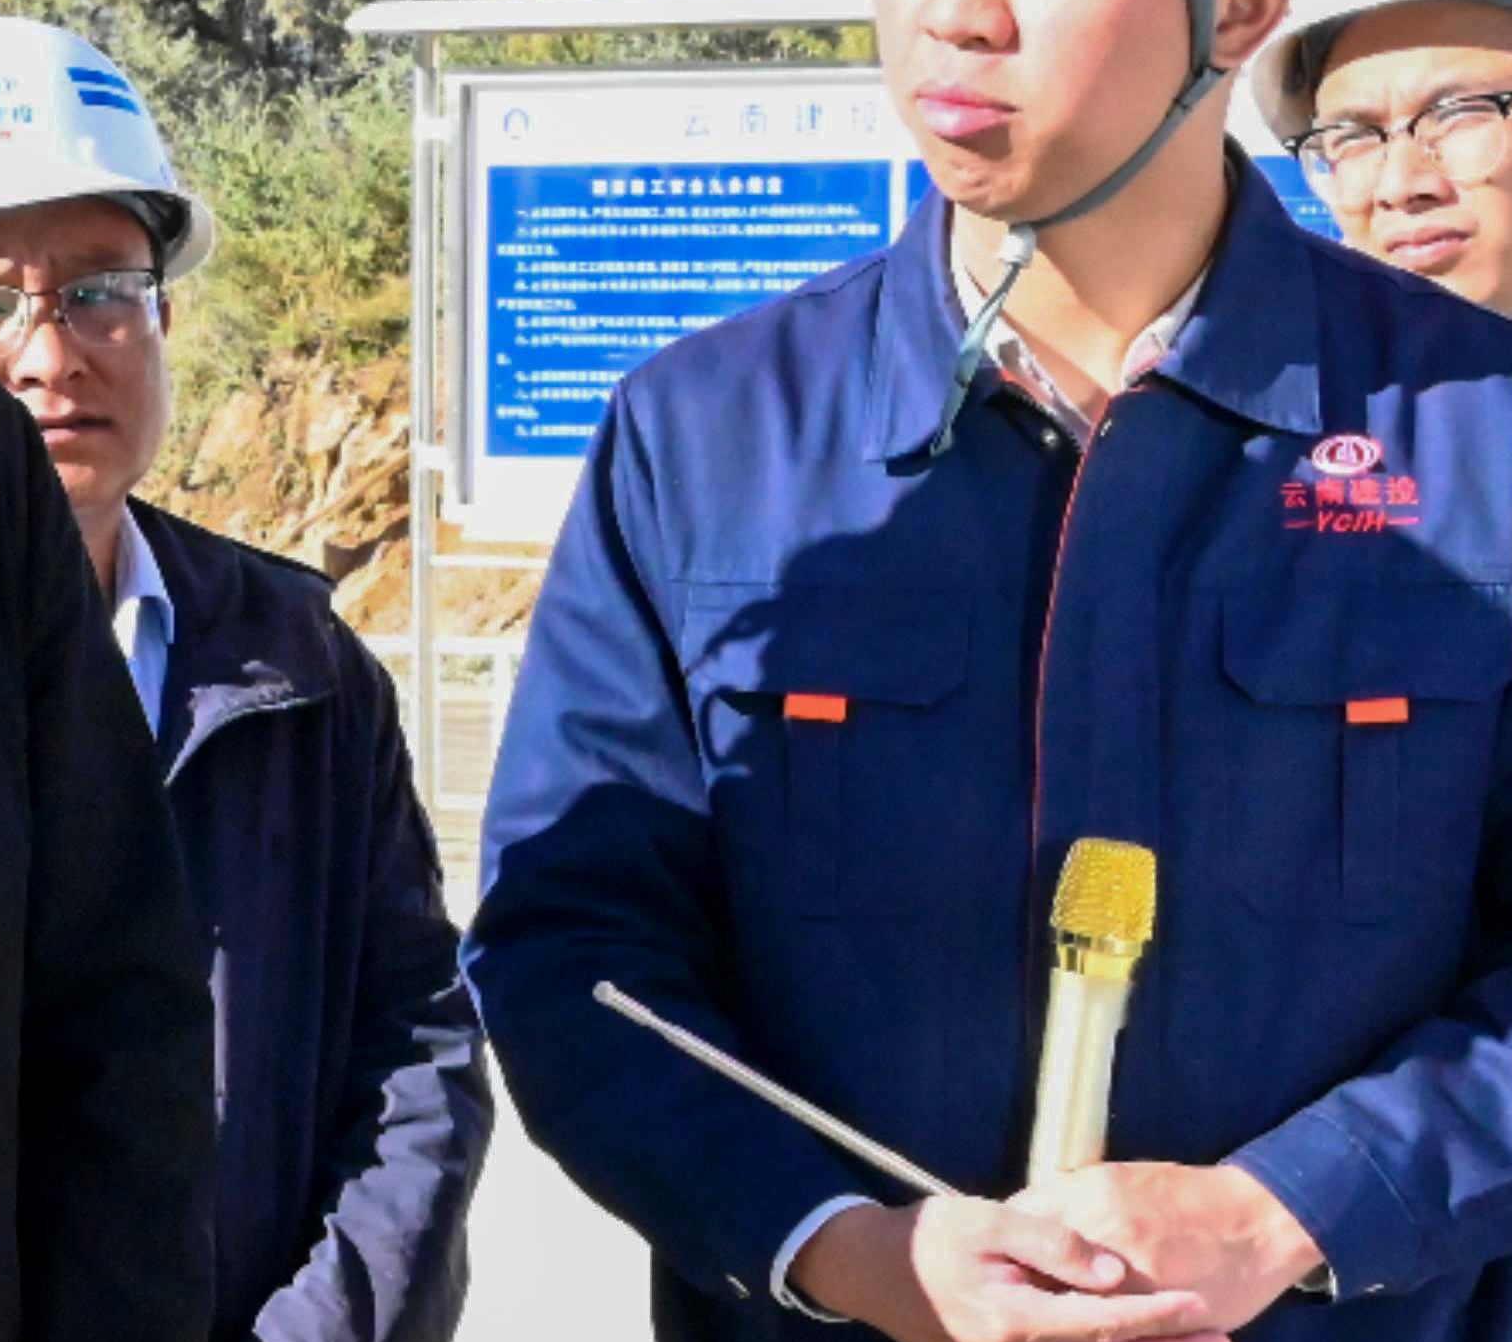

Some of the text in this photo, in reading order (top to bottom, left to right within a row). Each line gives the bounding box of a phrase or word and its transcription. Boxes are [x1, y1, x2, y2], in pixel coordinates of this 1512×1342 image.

[1279, 476, 1420, 508] 云南建投
[1317, 509, 1389, 533] YCIH
